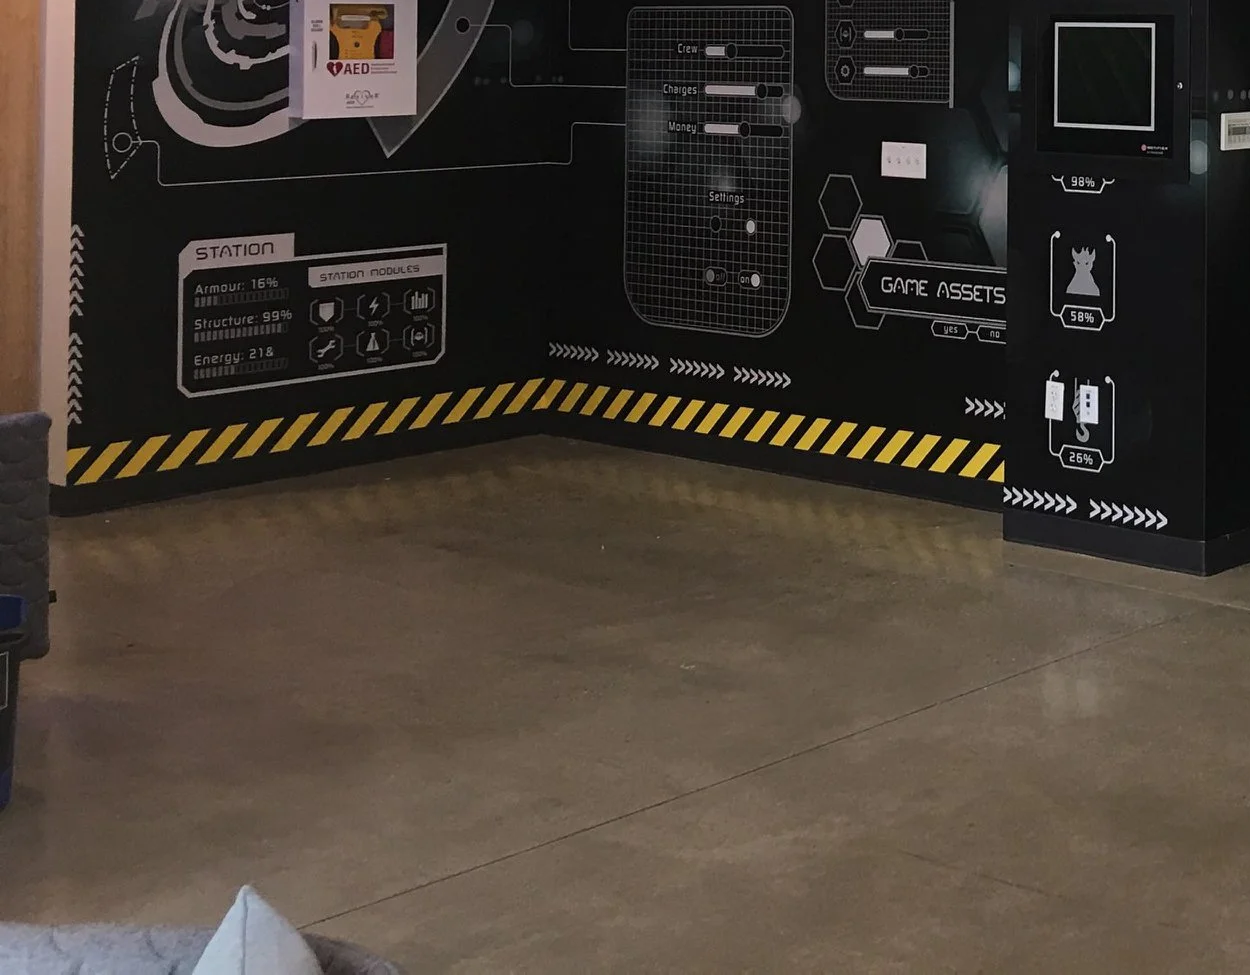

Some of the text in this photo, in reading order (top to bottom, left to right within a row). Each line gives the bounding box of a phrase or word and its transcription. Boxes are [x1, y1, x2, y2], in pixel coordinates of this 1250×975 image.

[677, 43, 698, 54] Crew
[343, 62, 370, 75] AED
[663, 83, 698, 97] Charges
[668, 121, 697, 135] Money
[1071, 176, 1095, 188] 98%
[708, 191, 745, 205] Settings
[195, 241, 274, 261] STATION
[319, 264, 420, 282] STATION MODULES
[740, 275, 750, 284] on
[194, 277, 279, 295] Armour: 16%
[881, 276, 1006, 305] GAME ASSETS
[193, 309, 293, 331] Structure: 99%
[1070, 310, 1095, 323] 58%
[943, 324, 959, 335] yes
[989, 330, 1001, 339] no
[193, 346, 274, 366] Energy: 21&
[1069, 451, 1094, 465] 26%
